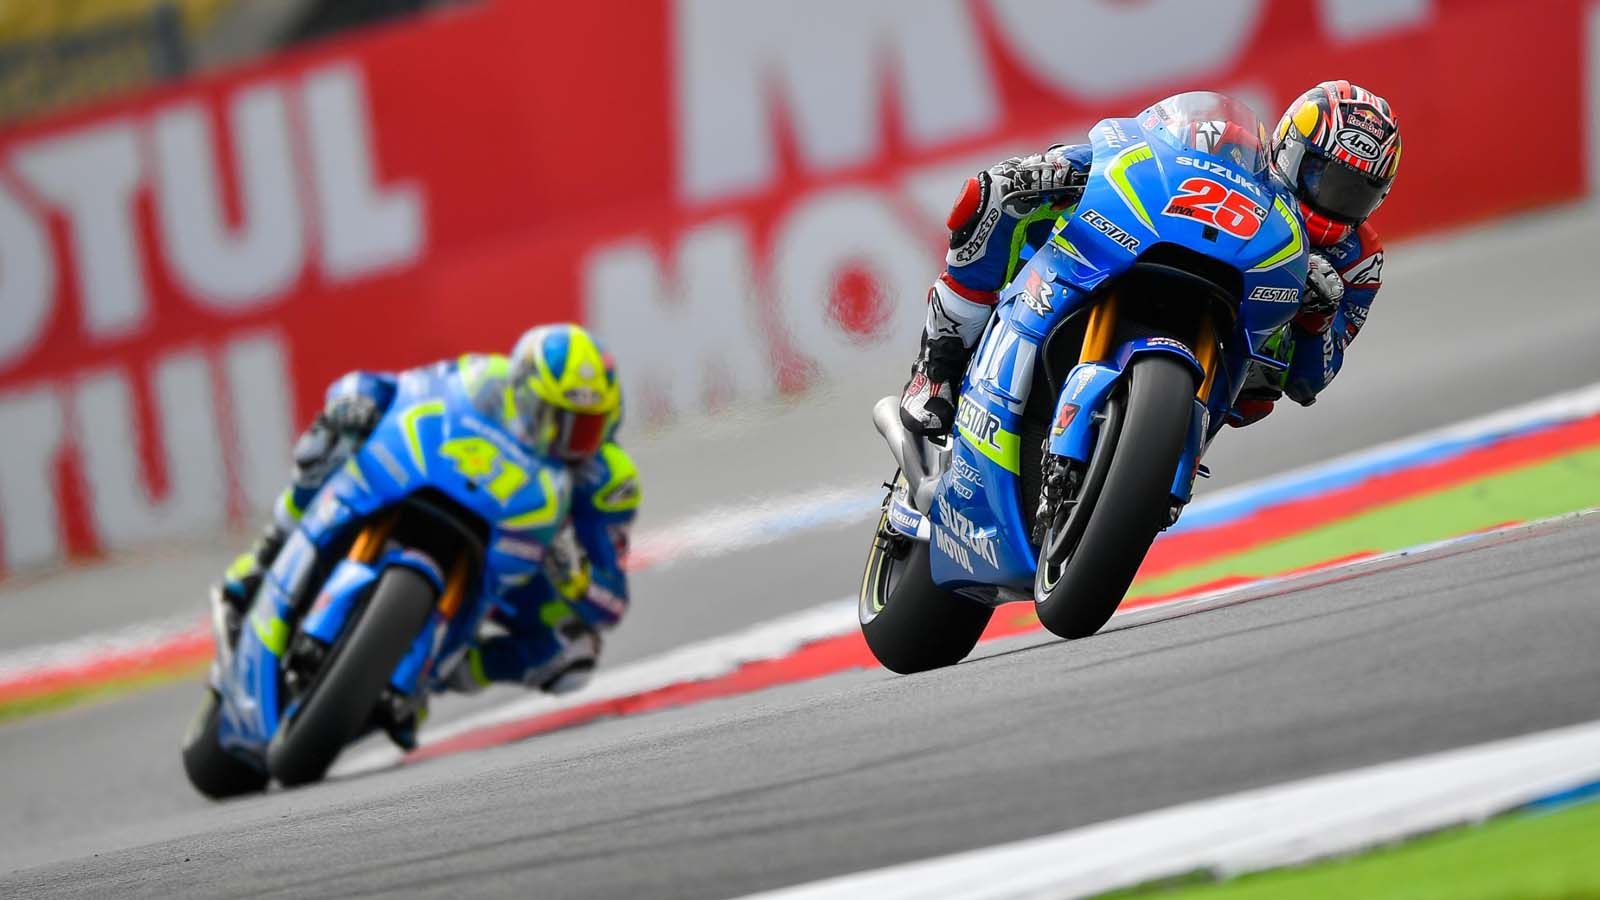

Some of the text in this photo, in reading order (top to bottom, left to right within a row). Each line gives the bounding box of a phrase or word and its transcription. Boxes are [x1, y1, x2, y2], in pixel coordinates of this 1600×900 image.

[1341, 131, 1378, 156] Arai
[1175, 155, 1261, 197] SUZUKI
[1080, 209, 1140, 256] ECSTAR
[1161, 177, 1262, 240] 25
[1248, 286, 1300, 303] ECSTAR
[437, 436, 529, 507] 41
[935, 525, 974, 574] MOTUL
[938, 495, 999, 570] SUZUKI
